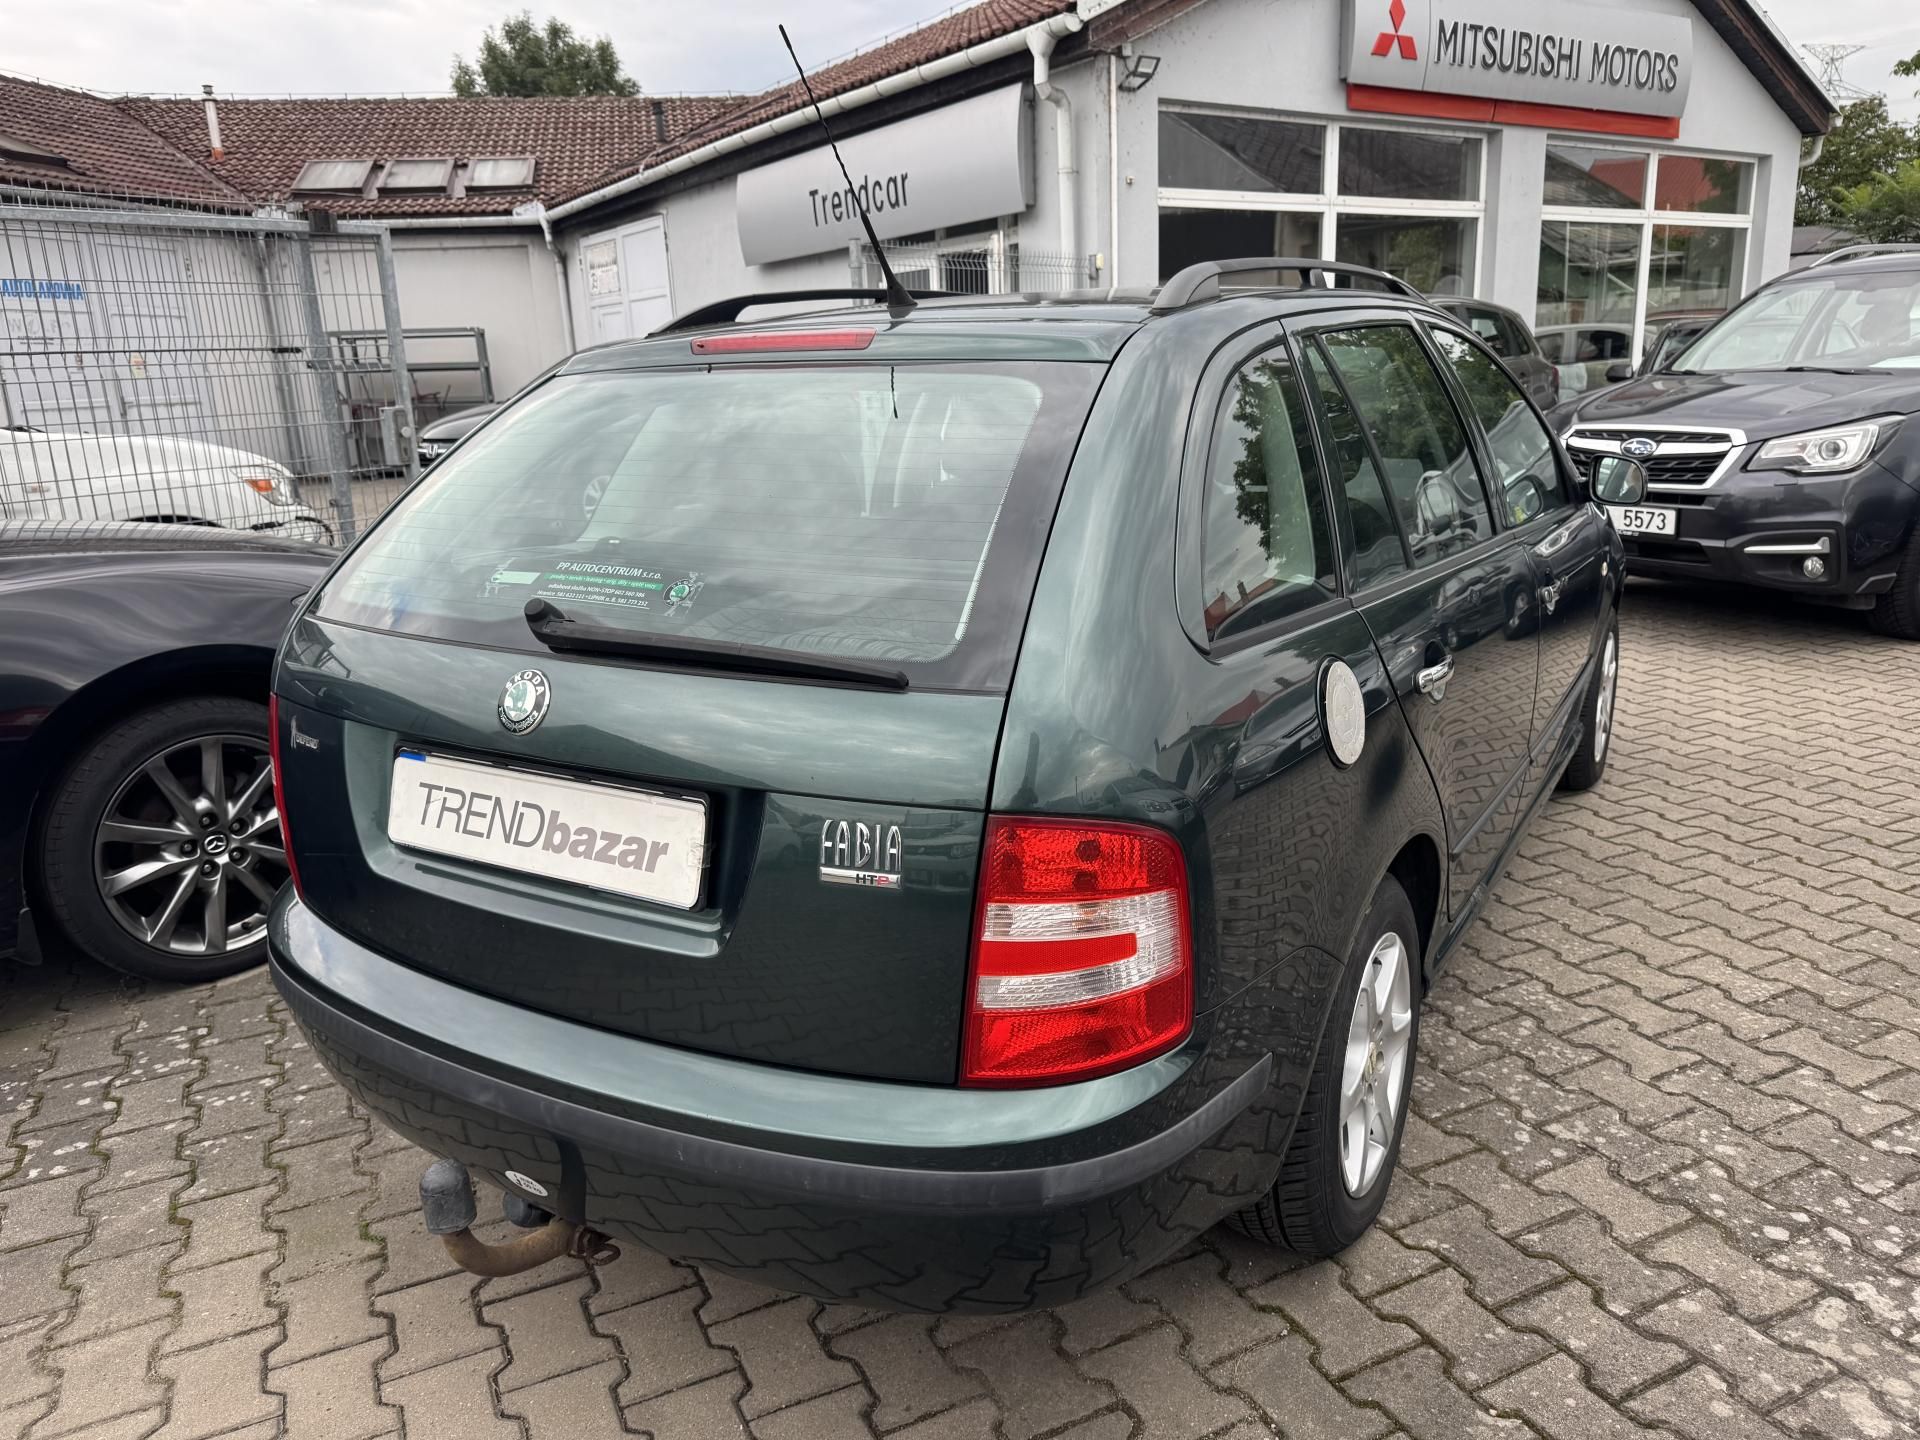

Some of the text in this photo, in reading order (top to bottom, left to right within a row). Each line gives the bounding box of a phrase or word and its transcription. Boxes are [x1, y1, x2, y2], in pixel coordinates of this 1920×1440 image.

[1434, 18, 1679, 93] MITSUBISHI MOTORS
[808, 171, 909, 228] Trendcar
[1623, 509, 1667, 531] 5573
[556, 561, 662, 579] PP AUTOCENTRUM s.r.o.
[587, 586, 616, 595] NON-STOP
[418, 781, 670, 874] TRENDbazar
[819, 819, 902, 872] FABIA
[855, 873, 890, 886] HTP
